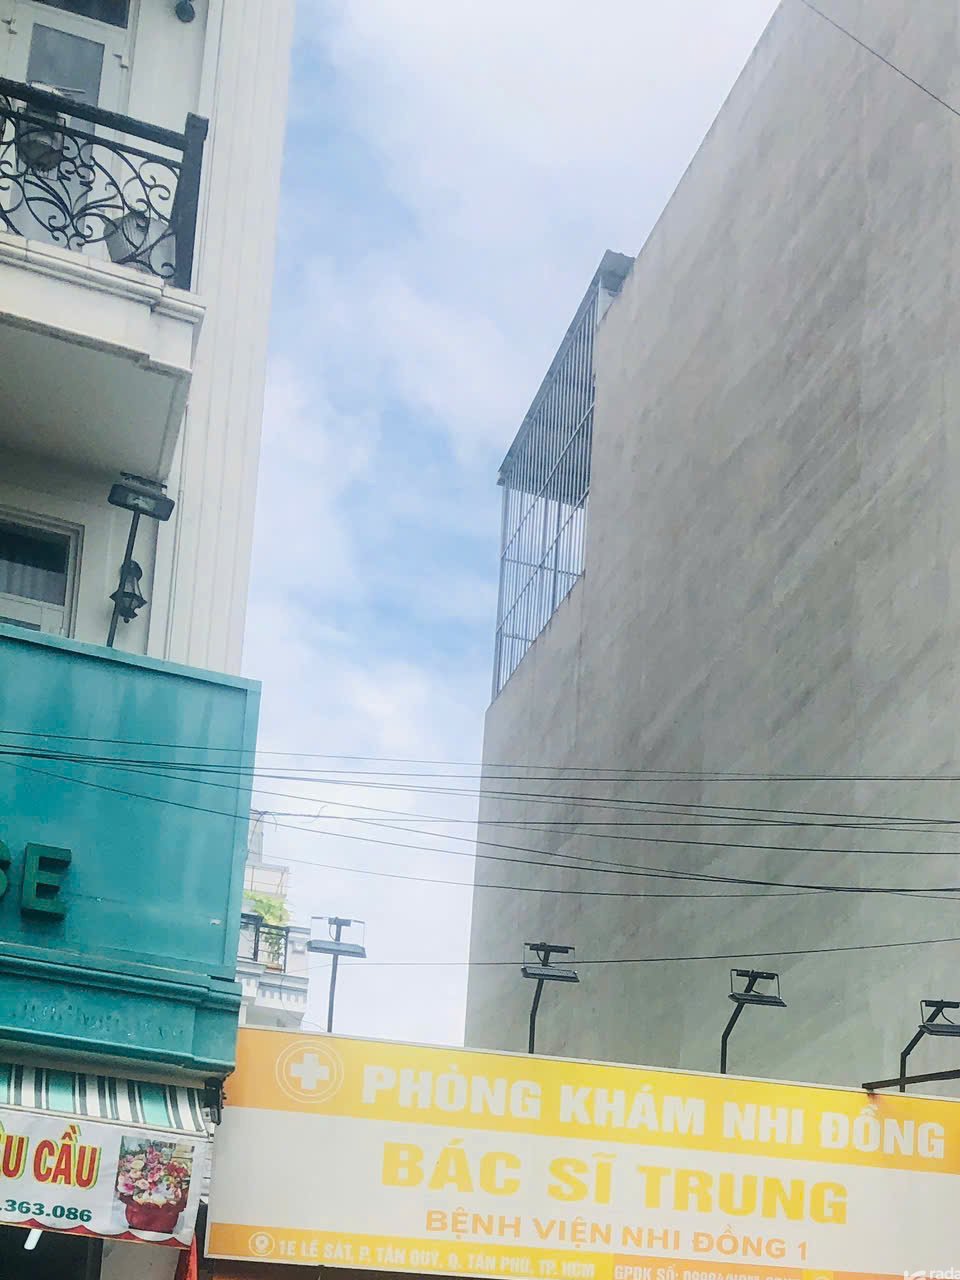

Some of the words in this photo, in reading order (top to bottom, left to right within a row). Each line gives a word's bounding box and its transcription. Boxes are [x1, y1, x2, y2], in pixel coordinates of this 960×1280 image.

[361, 1062, 542, 1121] PHÒNG
[560, 1082, 705, 1136] KHÁM
[723, 1103, 803, 1145] NHI
[820, 1104, 945, 1159] ĐỒNG
[0, 1122, 29, 1179] U
[33, 1124, 100, 1189] CẦU
[381, 1137, 522, 1197] BÁC
[546, 1152, 616, 1205] SĨ
[638, 1164, 848, 1225] TRUNG
[425, 1207, 521, 1240] BỆNH
[532, 1214, 613, 1249] VIỆN
[621, 1227, 680, 1251] NHI
[692, 1224, 786, 1260] ĐỒNG
[798, 1241, 808, 1260] 1
